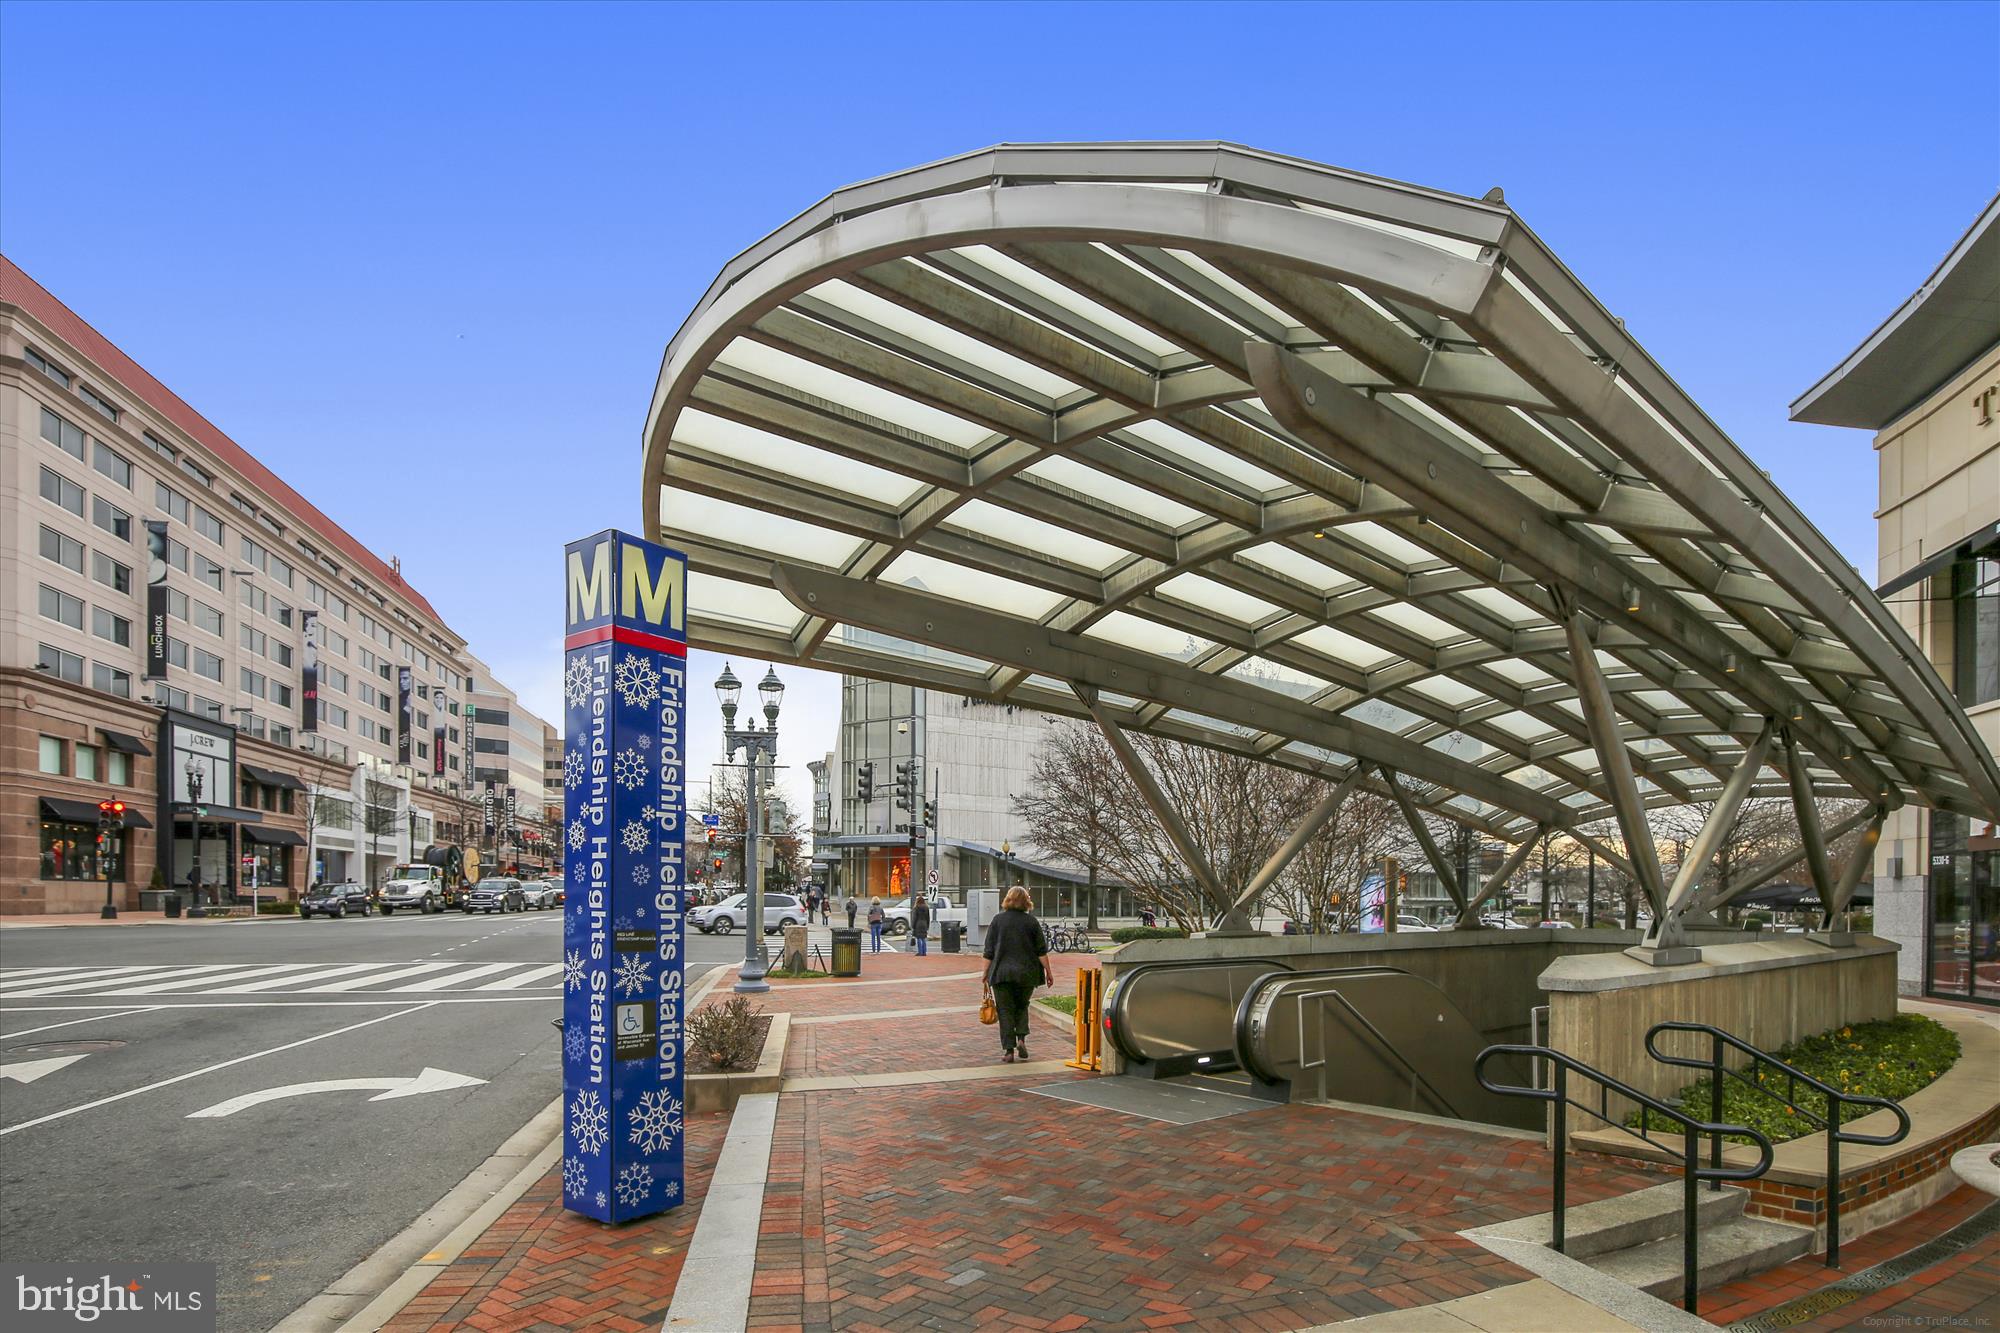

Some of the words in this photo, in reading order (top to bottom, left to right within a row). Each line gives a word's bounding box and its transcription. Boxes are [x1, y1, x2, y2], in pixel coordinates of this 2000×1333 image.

[1973, 381, 2000, 428] T
[568, 541, 610, 625] M
[621, 542, 684, 632] M
[155, 614, 163, 658] LUNCHBOX
[190, 733, 215, 748] J.CREW
[589, 653, 609, 826] Friendship
[655, 666, 683, 832] Friendship
[486, 788, 494, 804] OLD
[486, 805, 494, 826] NAVY
[507, 795, 515, 810] OLD
[588, 836, 607, 960] Heights
[655, 841, 682, 961] Heights
[589, 969, 607, 1084] Station
[659, 969, 682, 1081] Station
